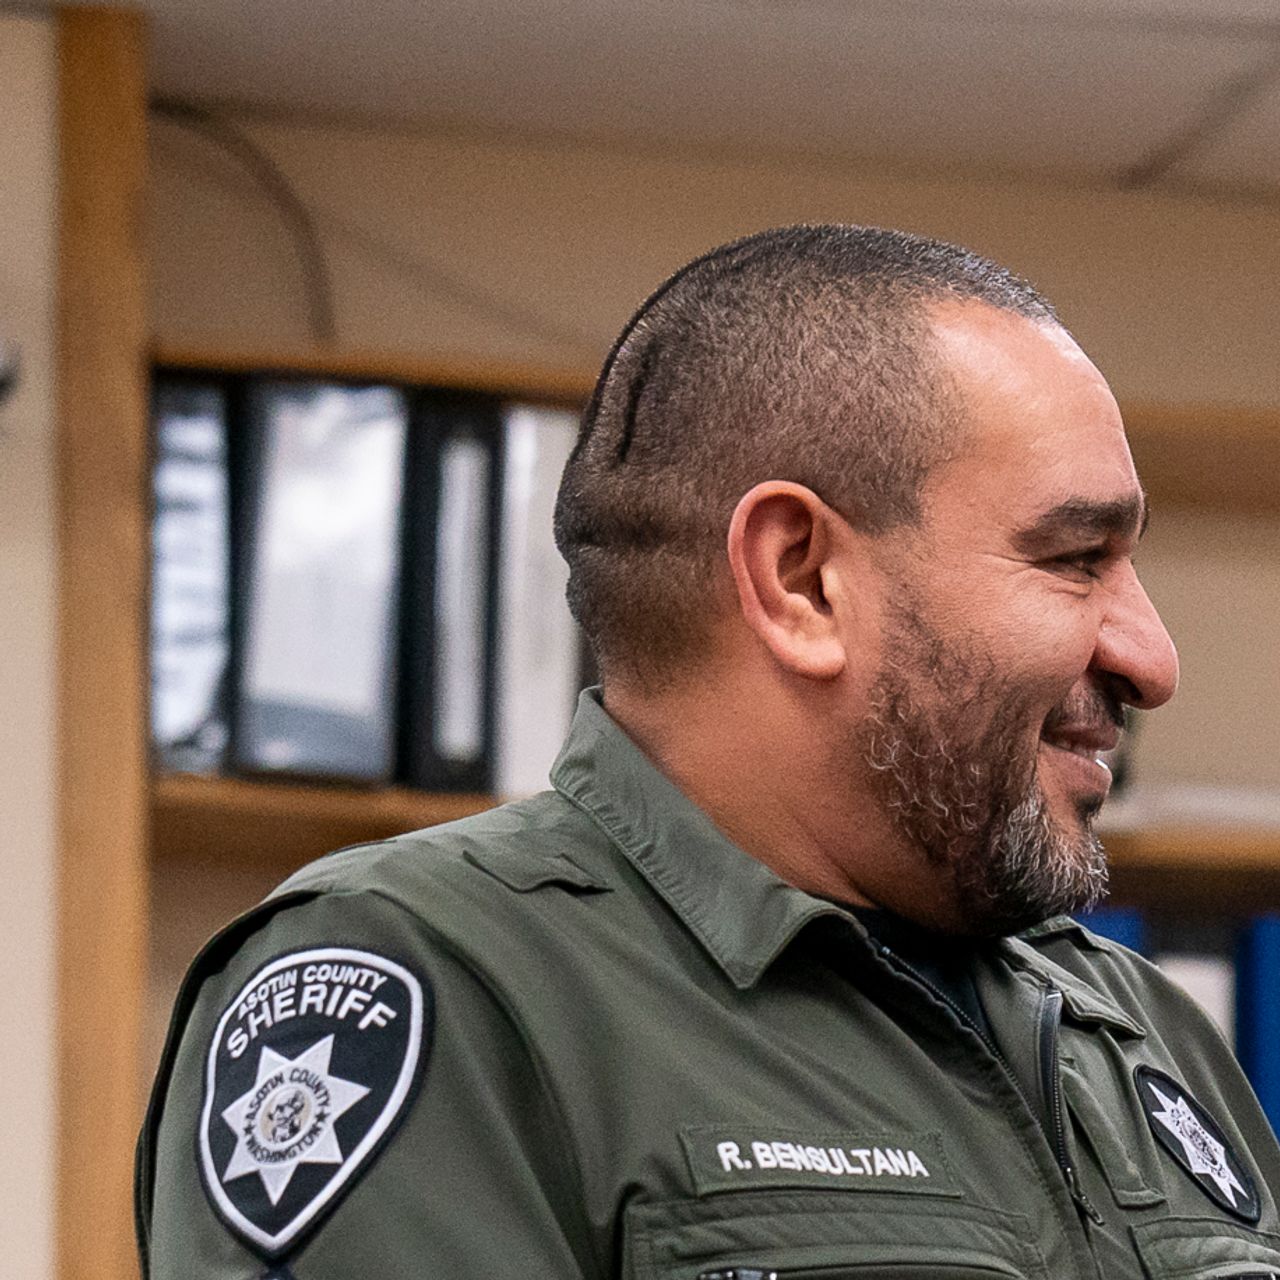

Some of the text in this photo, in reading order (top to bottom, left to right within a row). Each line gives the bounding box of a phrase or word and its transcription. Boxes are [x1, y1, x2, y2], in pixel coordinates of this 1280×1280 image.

[237, 965, 387, 1020] ASOTIN COUNTY
[227, 983, 397, 1059] SHERIFF
[716, 1141, 930, 1178] R. BENSULTANA
